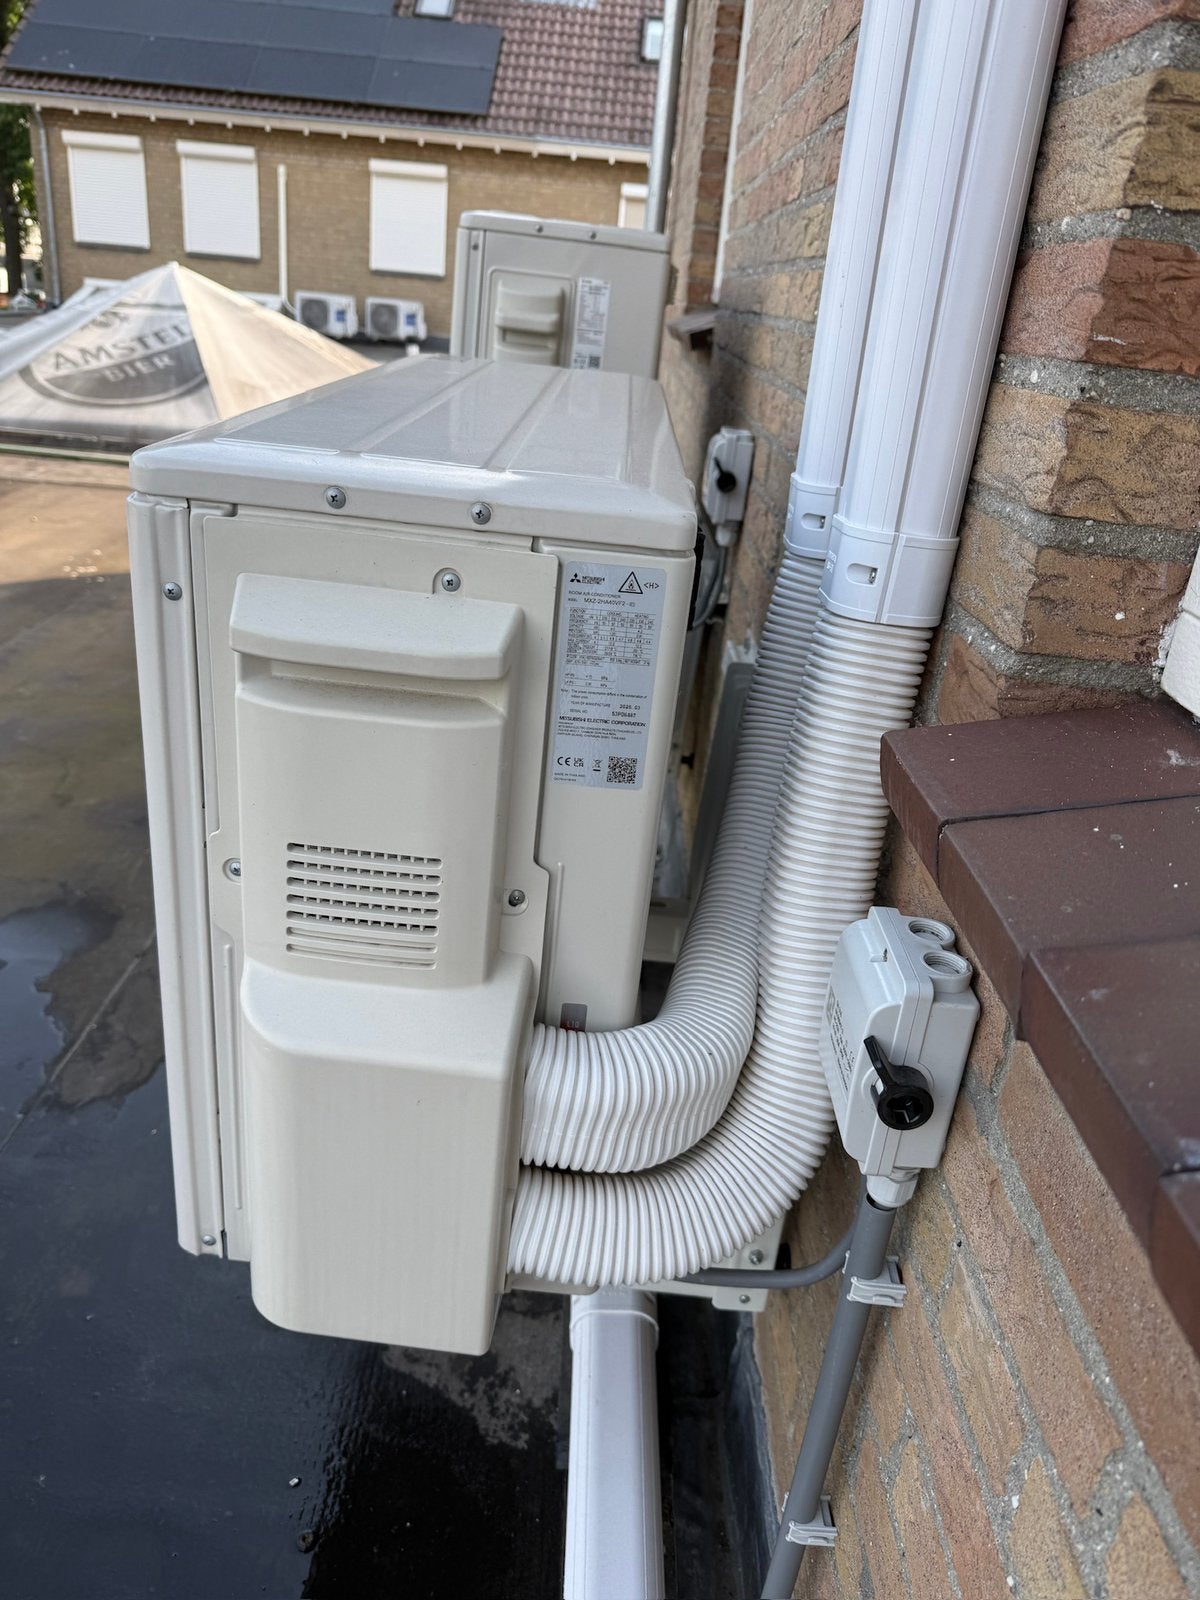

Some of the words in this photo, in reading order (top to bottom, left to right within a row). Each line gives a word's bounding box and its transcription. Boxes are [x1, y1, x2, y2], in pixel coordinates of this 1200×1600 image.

[53, 322, 189, 373] AMSTEL
[102, 352, 176, 383] BIER
[557, 756, 571, 766] CE
